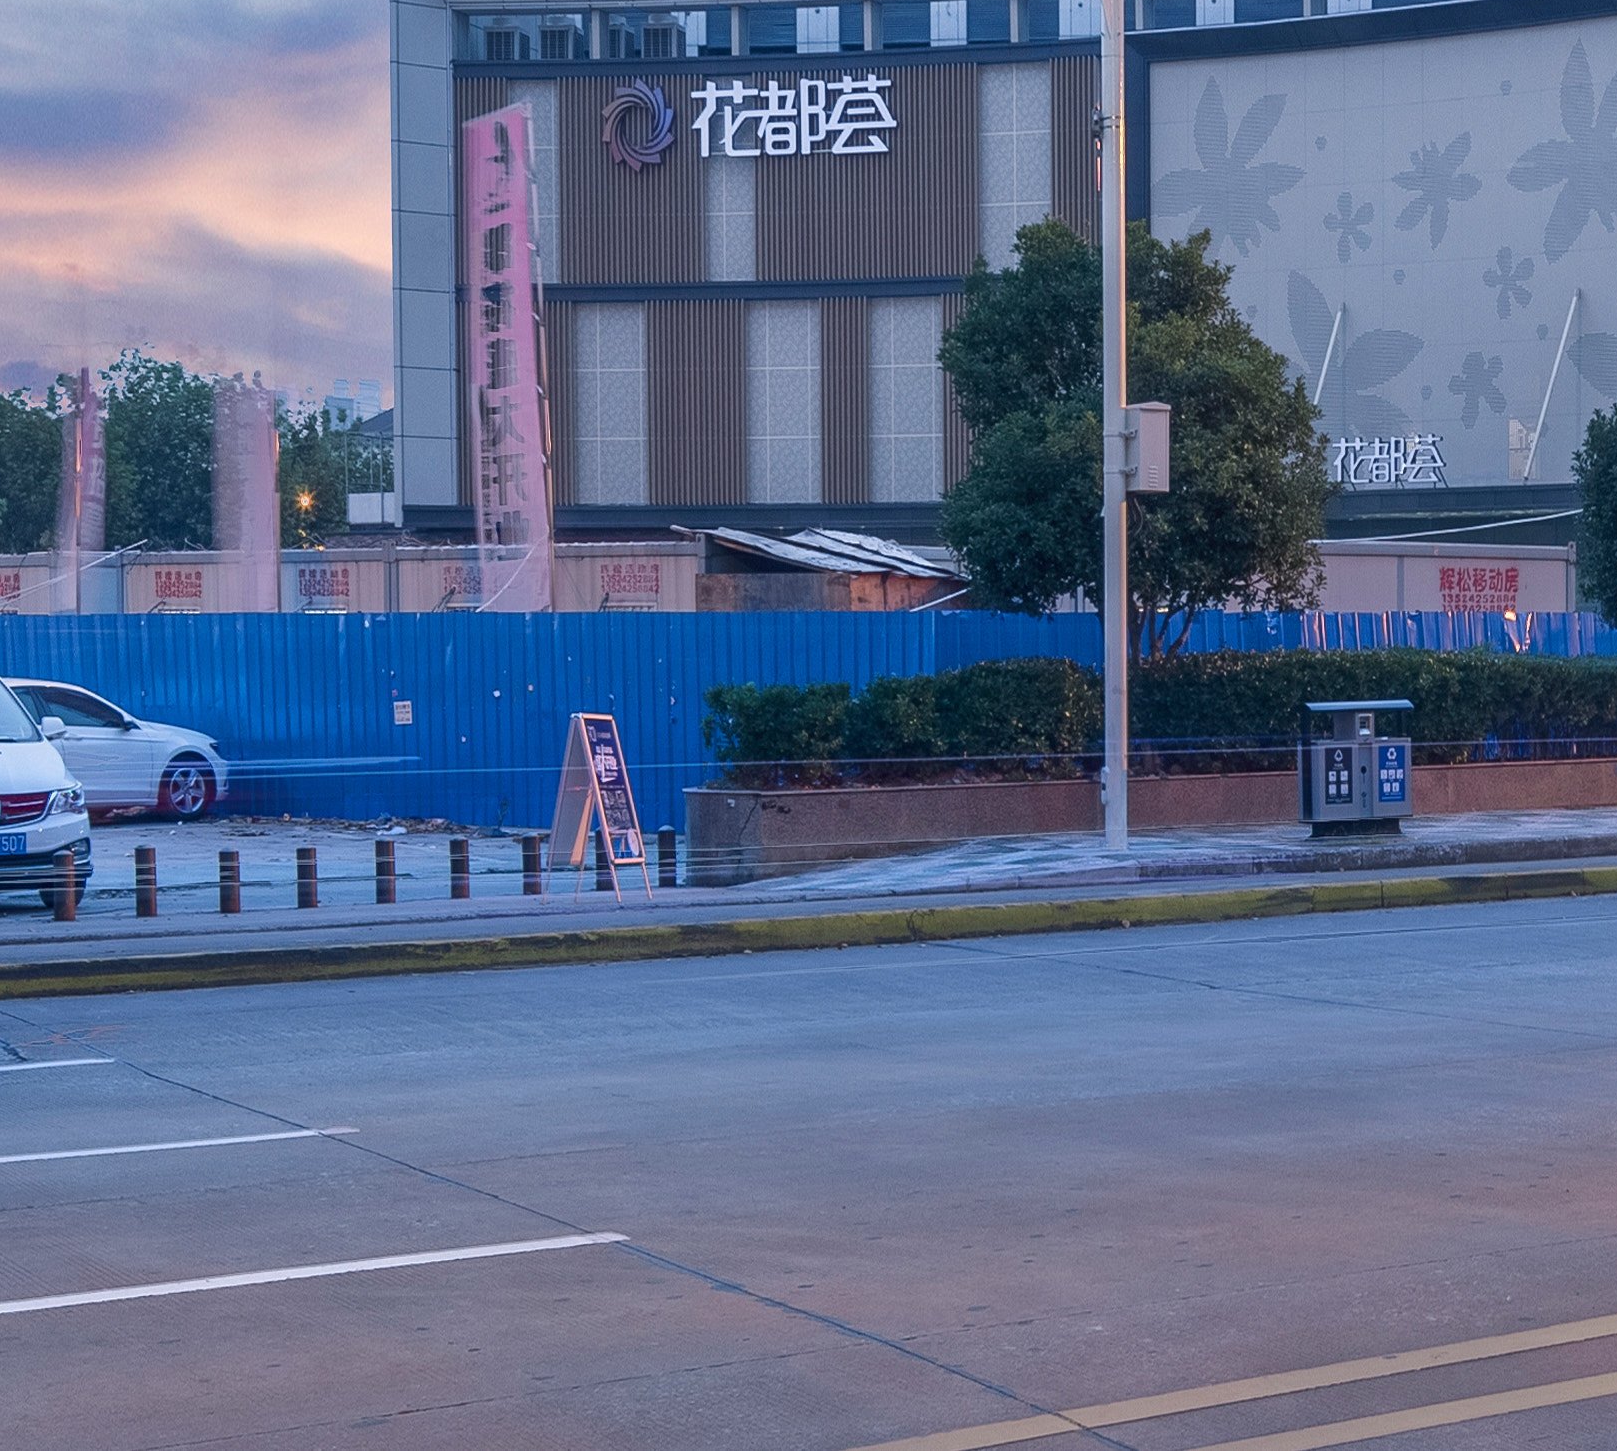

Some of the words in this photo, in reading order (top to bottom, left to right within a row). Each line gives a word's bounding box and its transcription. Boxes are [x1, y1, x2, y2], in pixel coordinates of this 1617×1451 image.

[690, 74, 898, 158] 花都荟
[1332, 433, 1446, 484] 花都荟
